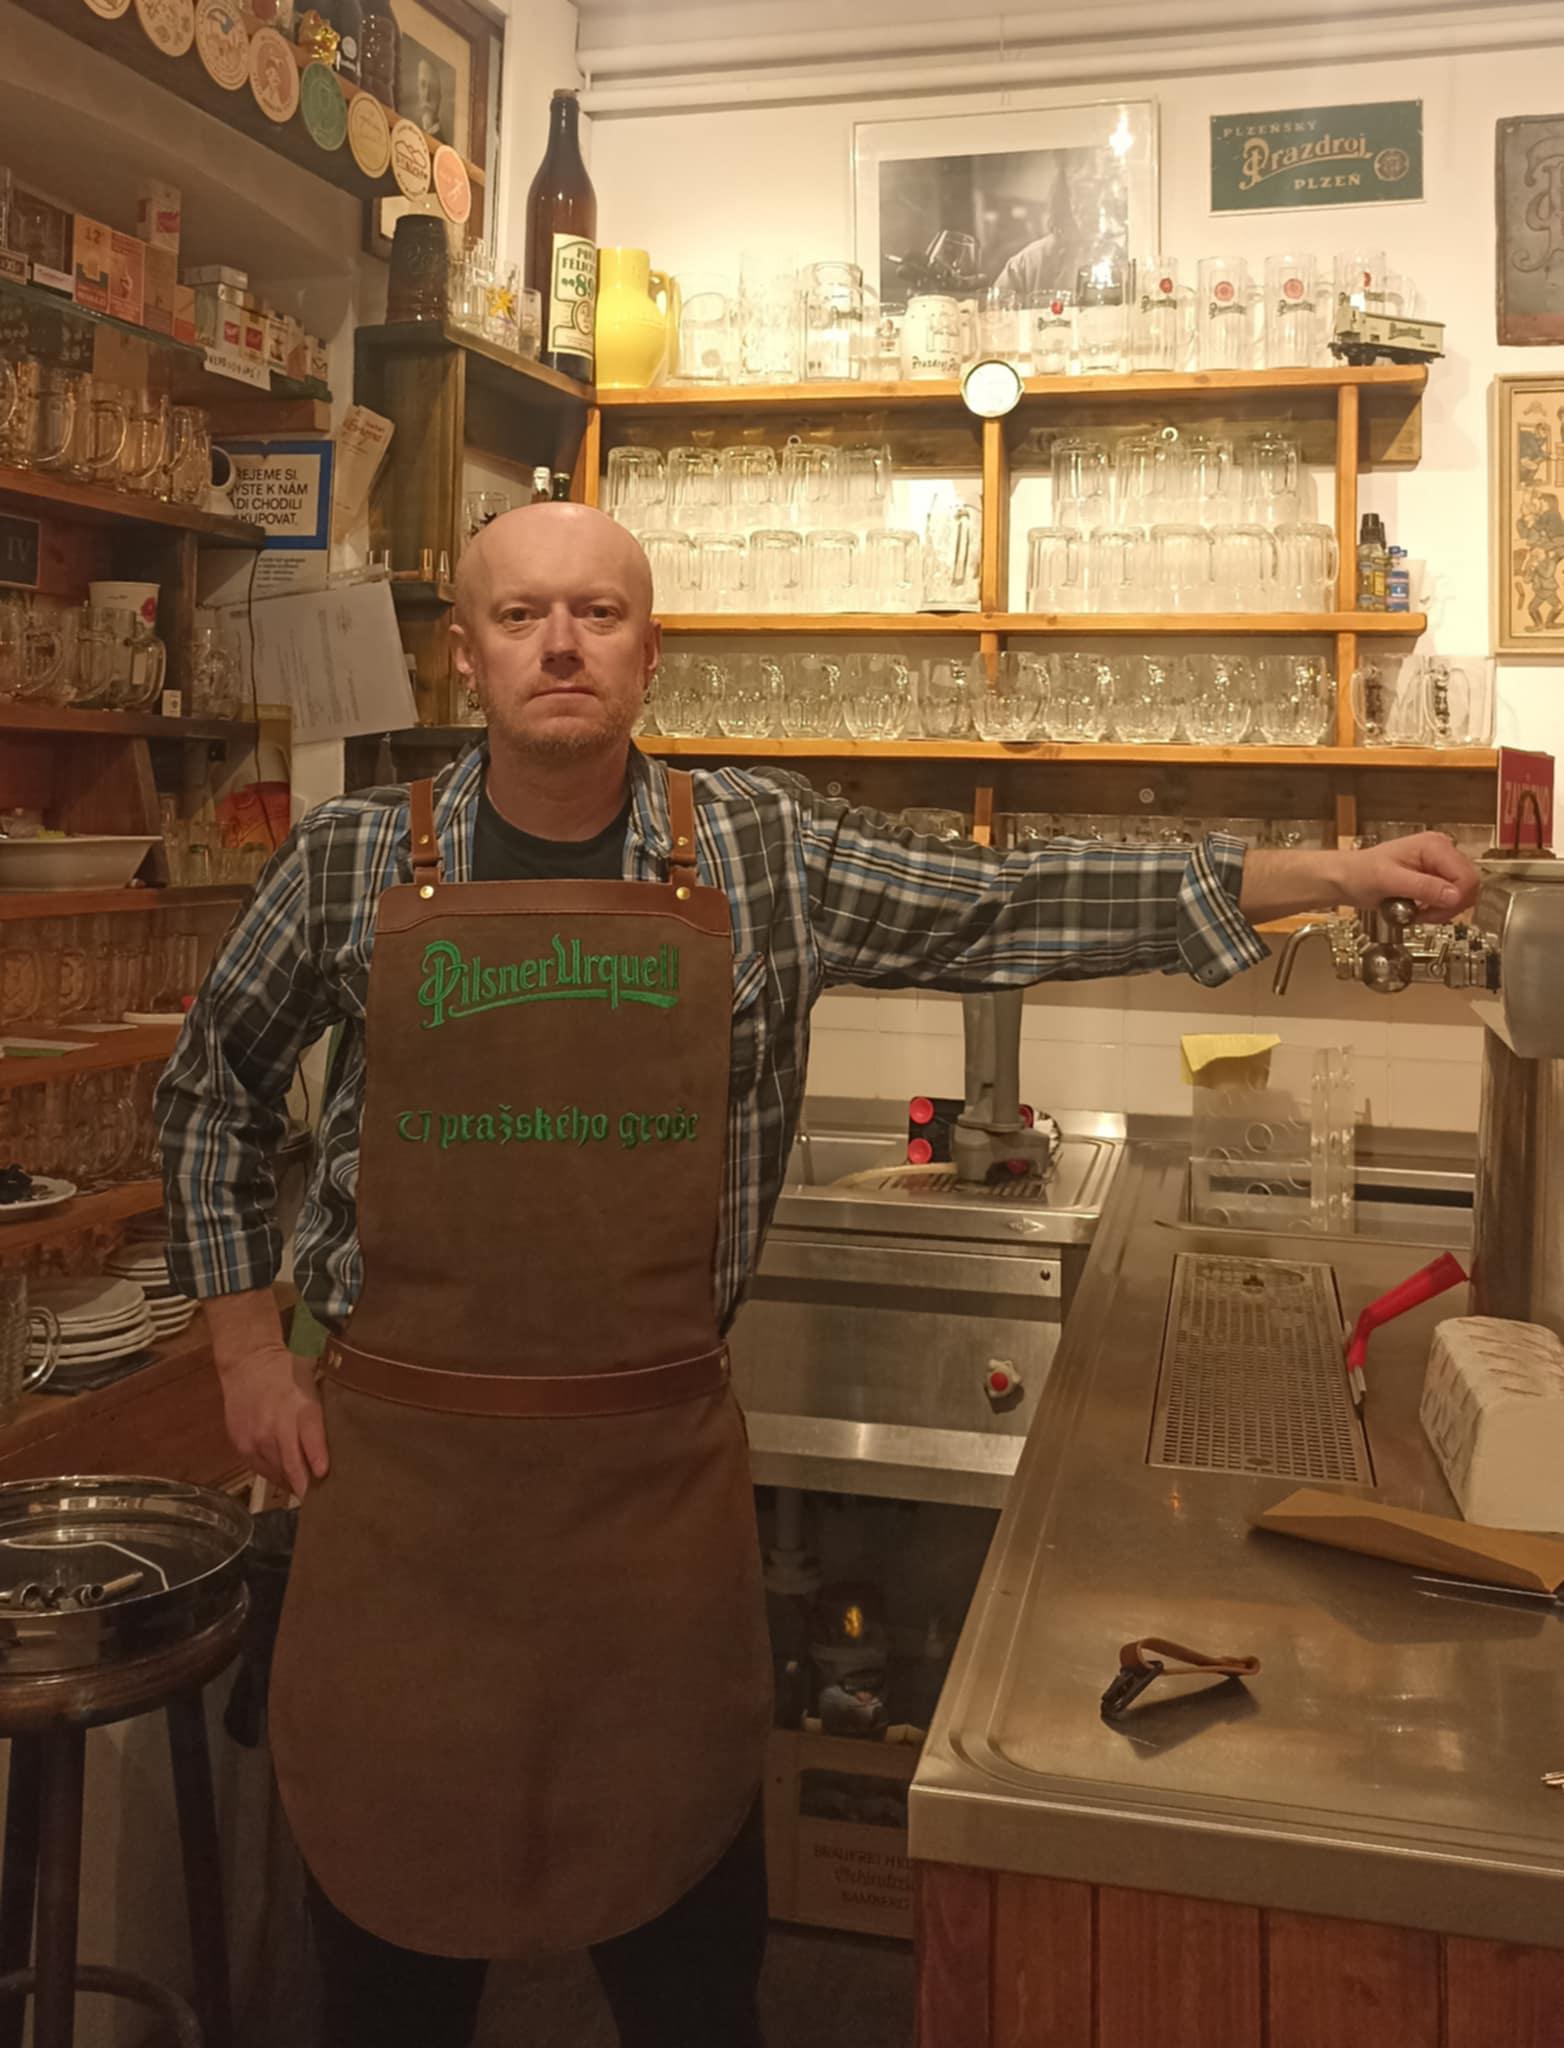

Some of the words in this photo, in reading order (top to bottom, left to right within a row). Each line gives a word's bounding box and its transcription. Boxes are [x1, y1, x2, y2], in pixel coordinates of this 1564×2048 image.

[1239, 134, 1371, 190] Prazdroj
[235, 466, 282, 481] EJEME
[230, 482, 263, 496] YSTE
[266, 482, 275, 496] K
[230, 497, 249, 510] DI
[251, 497, 303, 510] CHODILI
[418, 939, 554, 1029] Pilsner
[551, 934, 680, 1010] Urquell
[438, 1104, 609, 1150] pražského
